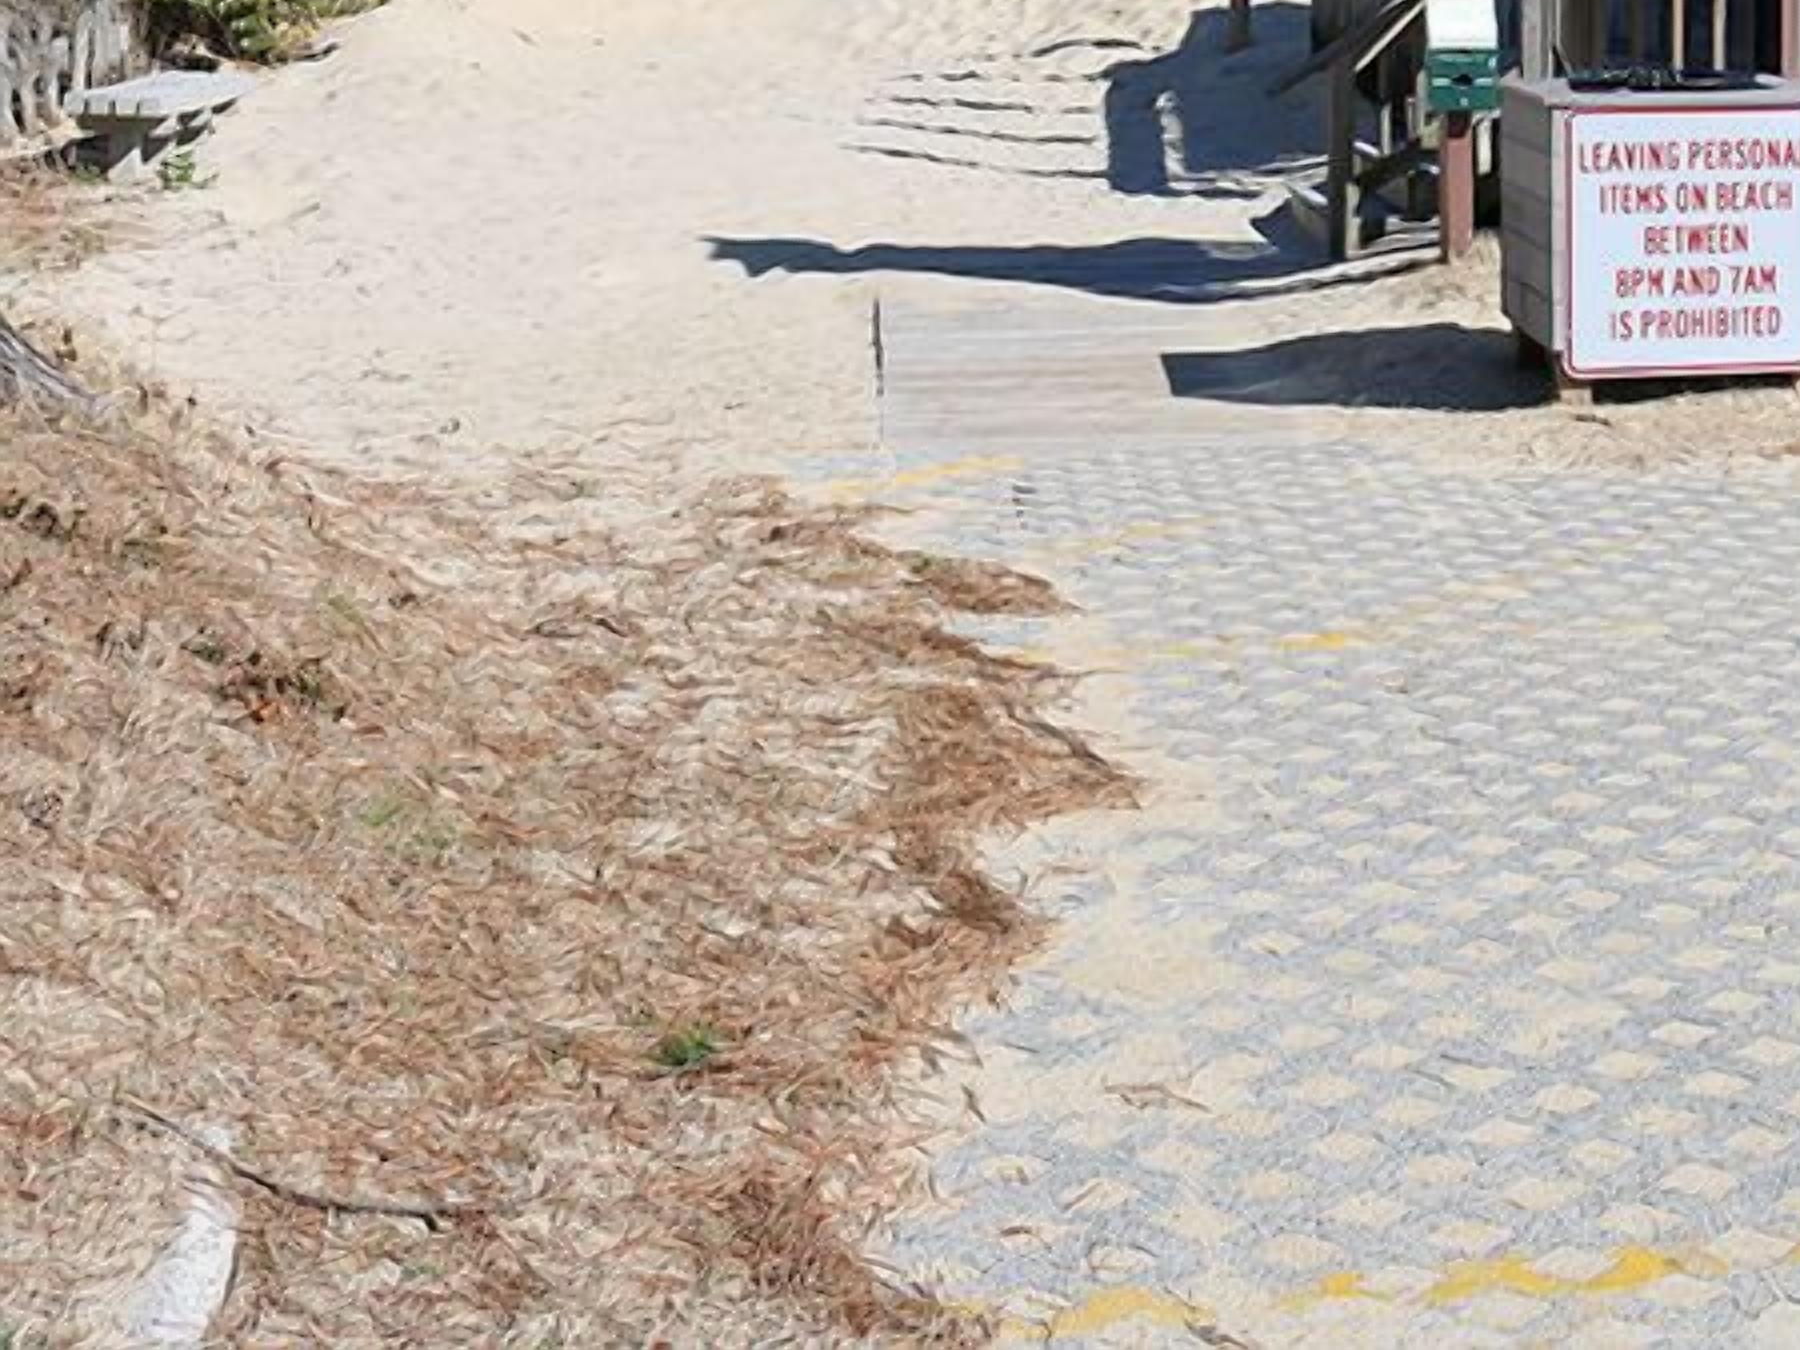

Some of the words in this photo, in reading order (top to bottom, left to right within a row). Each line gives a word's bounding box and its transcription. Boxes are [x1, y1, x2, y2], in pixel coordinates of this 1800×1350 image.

[1579, 140, 1680, 173] LEAVING
[1599, 183, 1668, 214] ITEMS
[1675, 181, 1708, 214] ON
[1715, 181, 1793, 211] BEACH
[1643, 223, 1749, 255] BETWEEN
[1615, 267, 1665, 298] 8PM
[1672, 265, 1721, 297] AND
[1728, 264, 1777, 295] 7AM
[1609, 309, 1633, 340] IS
[1639, 305, 1781, 339] PROHIBITED
